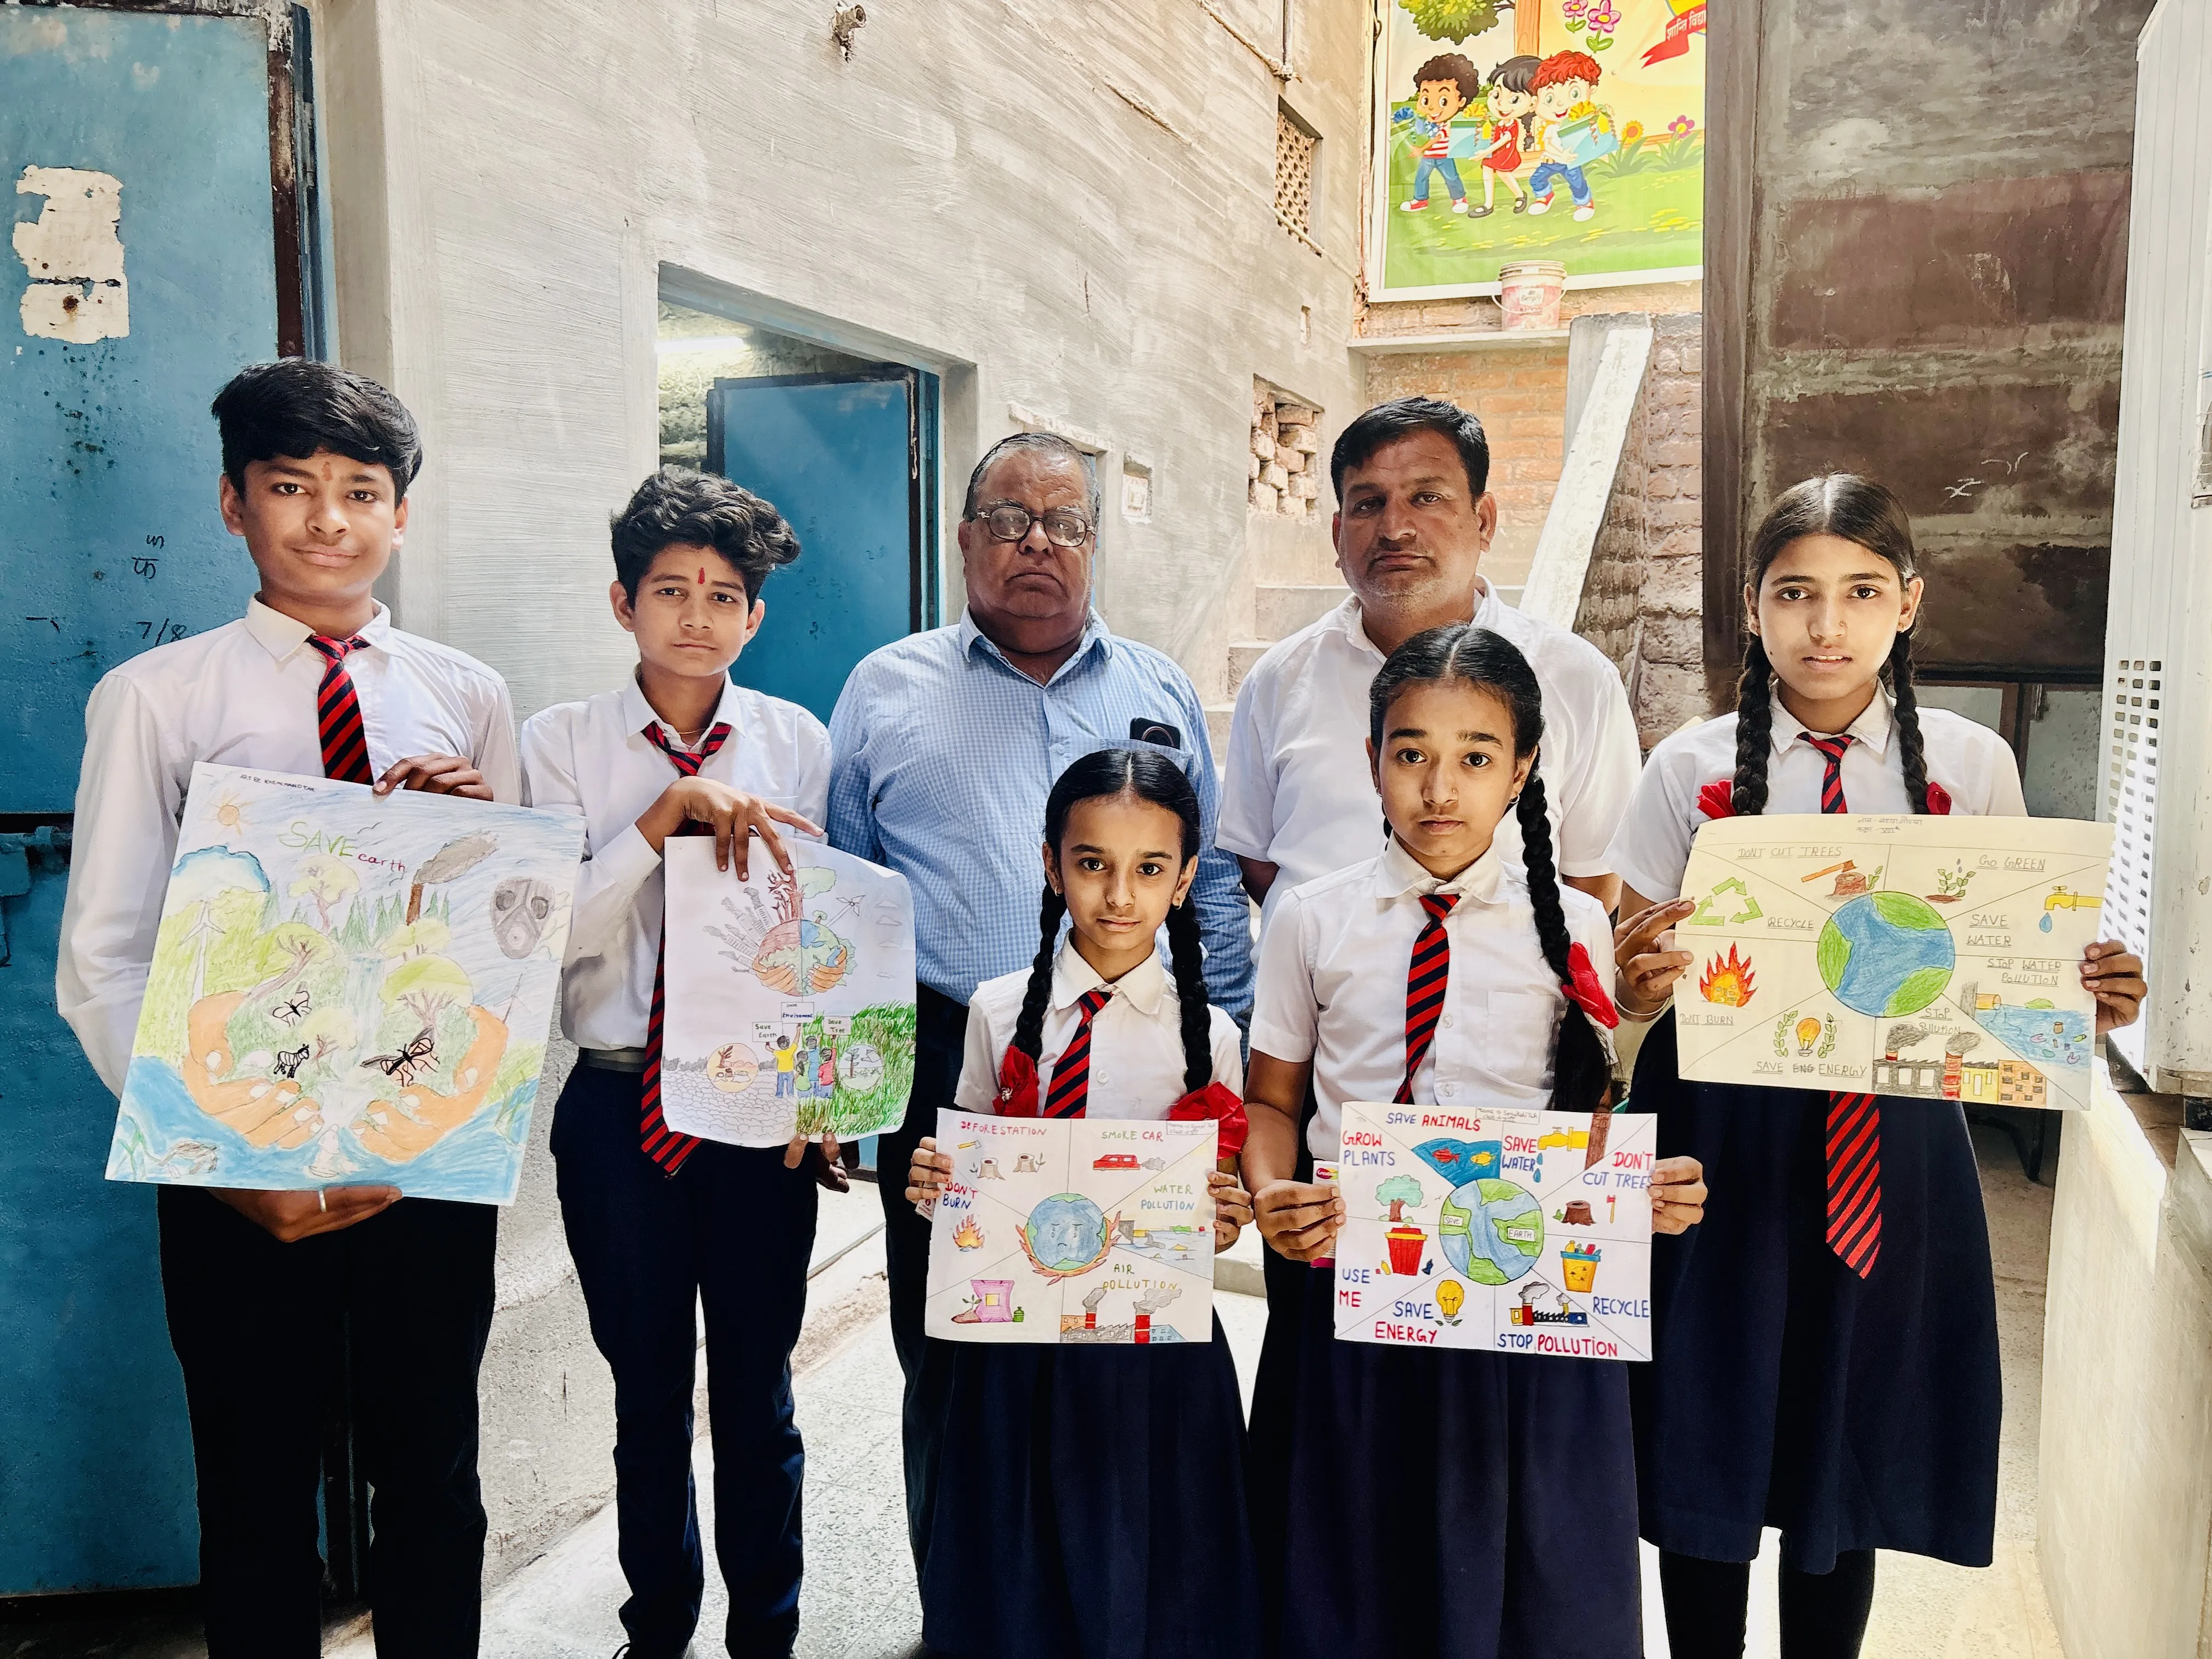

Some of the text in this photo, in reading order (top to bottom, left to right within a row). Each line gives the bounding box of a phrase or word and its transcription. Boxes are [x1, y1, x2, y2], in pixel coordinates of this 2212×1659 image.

[276, 821, 407, 873] SAVE earth
[1771, 847, 1795, 856] CUT
[1800, 847, 1842, 857] TREES
[2004, 856, 2046, 870] GREEN
[1767, 917, 1814, 929] RECYCLE
[1971, 914, 2008, 927] SAVE
[1966, 935, 2012, 946] WATER
[2022, 960, 2062, 970] WATER
[1706, 1014, 1734, 1025] BURN
[1756, 1061, 1784, 1071] SAVE
[1819, 1063, 1867, 1077] ENERGY
[961, 1121, 1047, 1136] DEFORESTATION
[1386, 1112, 1481, 1132] SAVE ANIMALS
[1142, 1131, 1164, 1142] CAR
[1342, 1130, 1383, 1147] GROW
[1502, 1135, 1537, 1153] SAVE
[1344, 1149, 1396, 1166] PLANTS
[1502, 1154, 1536, 1172] WATER
[1612, 1150, 1654, 1171] DON'T
[1583, 1171, 1610, 1186] CUT
[945, 1182, 978, 1200] DON'T
[1154, 1184, 1193, 1194] WATER
[943, 1193, 972, 1209] BURN
[1141, 1199, 1195, 1211] POLLUTION
[1509, 1229, 1532, 1239] EARTH
[1114, 1263, 1135, 1275] AIR
[1342, 1268, 1370, 1284] USE
[1102, 1279, 1178, 1291] POLLUTION
[1339, 1290, 1362, 1307] ME
[1392, 1301, 1435, 1319] SAVE
[1593, 1296, 1650, 1318] RECYCLE
[1375, 1321, 1437, 1344] ENERGY
[1497, 1334, 1533, 1349] STOP
